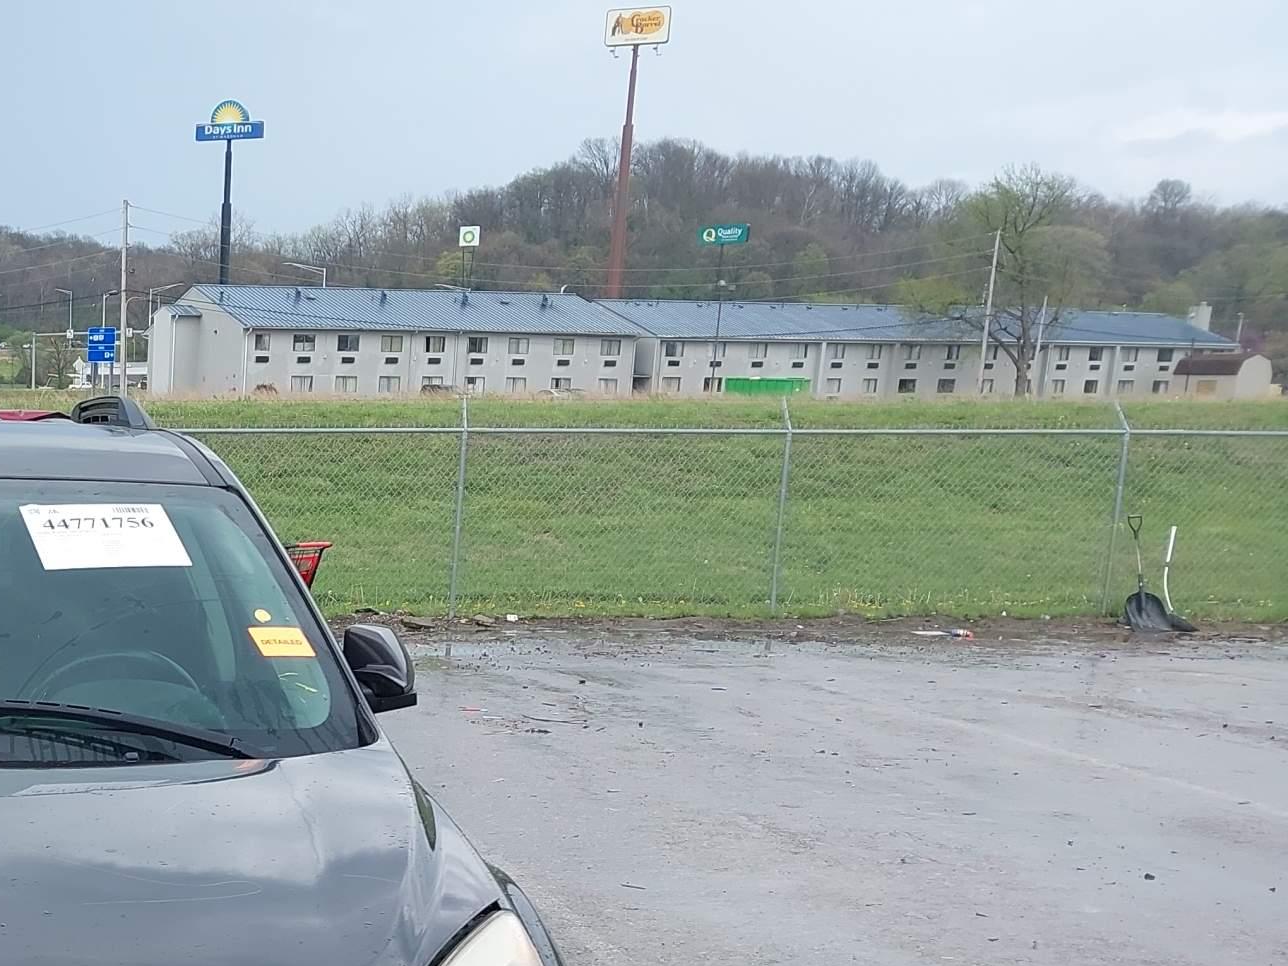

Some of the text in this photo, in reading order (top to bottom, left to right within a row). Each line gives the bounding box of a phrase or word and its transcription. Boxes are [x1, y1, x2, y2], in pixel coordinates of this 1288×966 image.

[205, 123, 252, 135] Days Inn
[717, 227, 743, 238] Quality
[42, 517, 155, 530] 44771756
